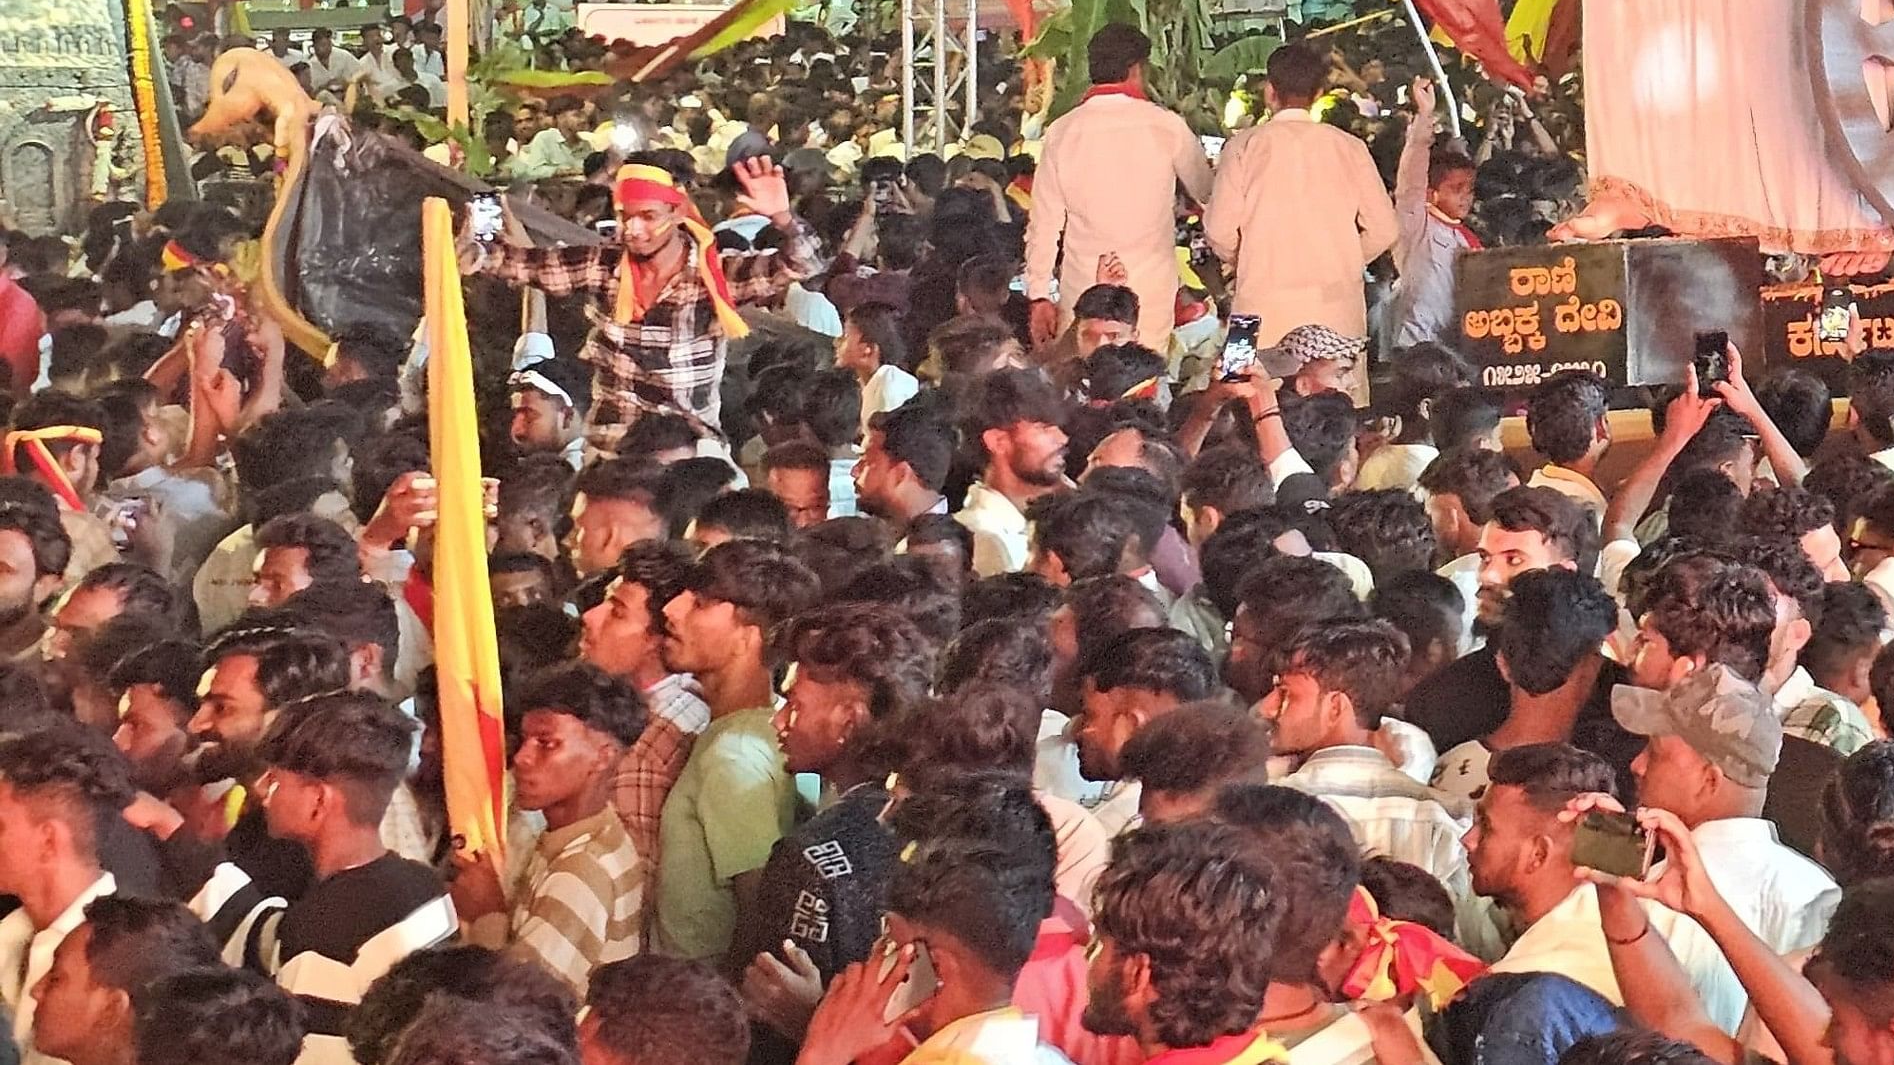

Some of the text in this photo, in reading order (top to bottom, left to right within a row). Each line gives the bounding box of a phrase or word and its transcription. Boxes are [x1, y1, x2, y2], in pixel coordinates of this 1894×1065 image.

[1510, 256, 1576, 296] ರಾಣಿ
[1464, 295, 1622, 354] ಅಬ್ಬಕ್ಕ ದೇವಿ
